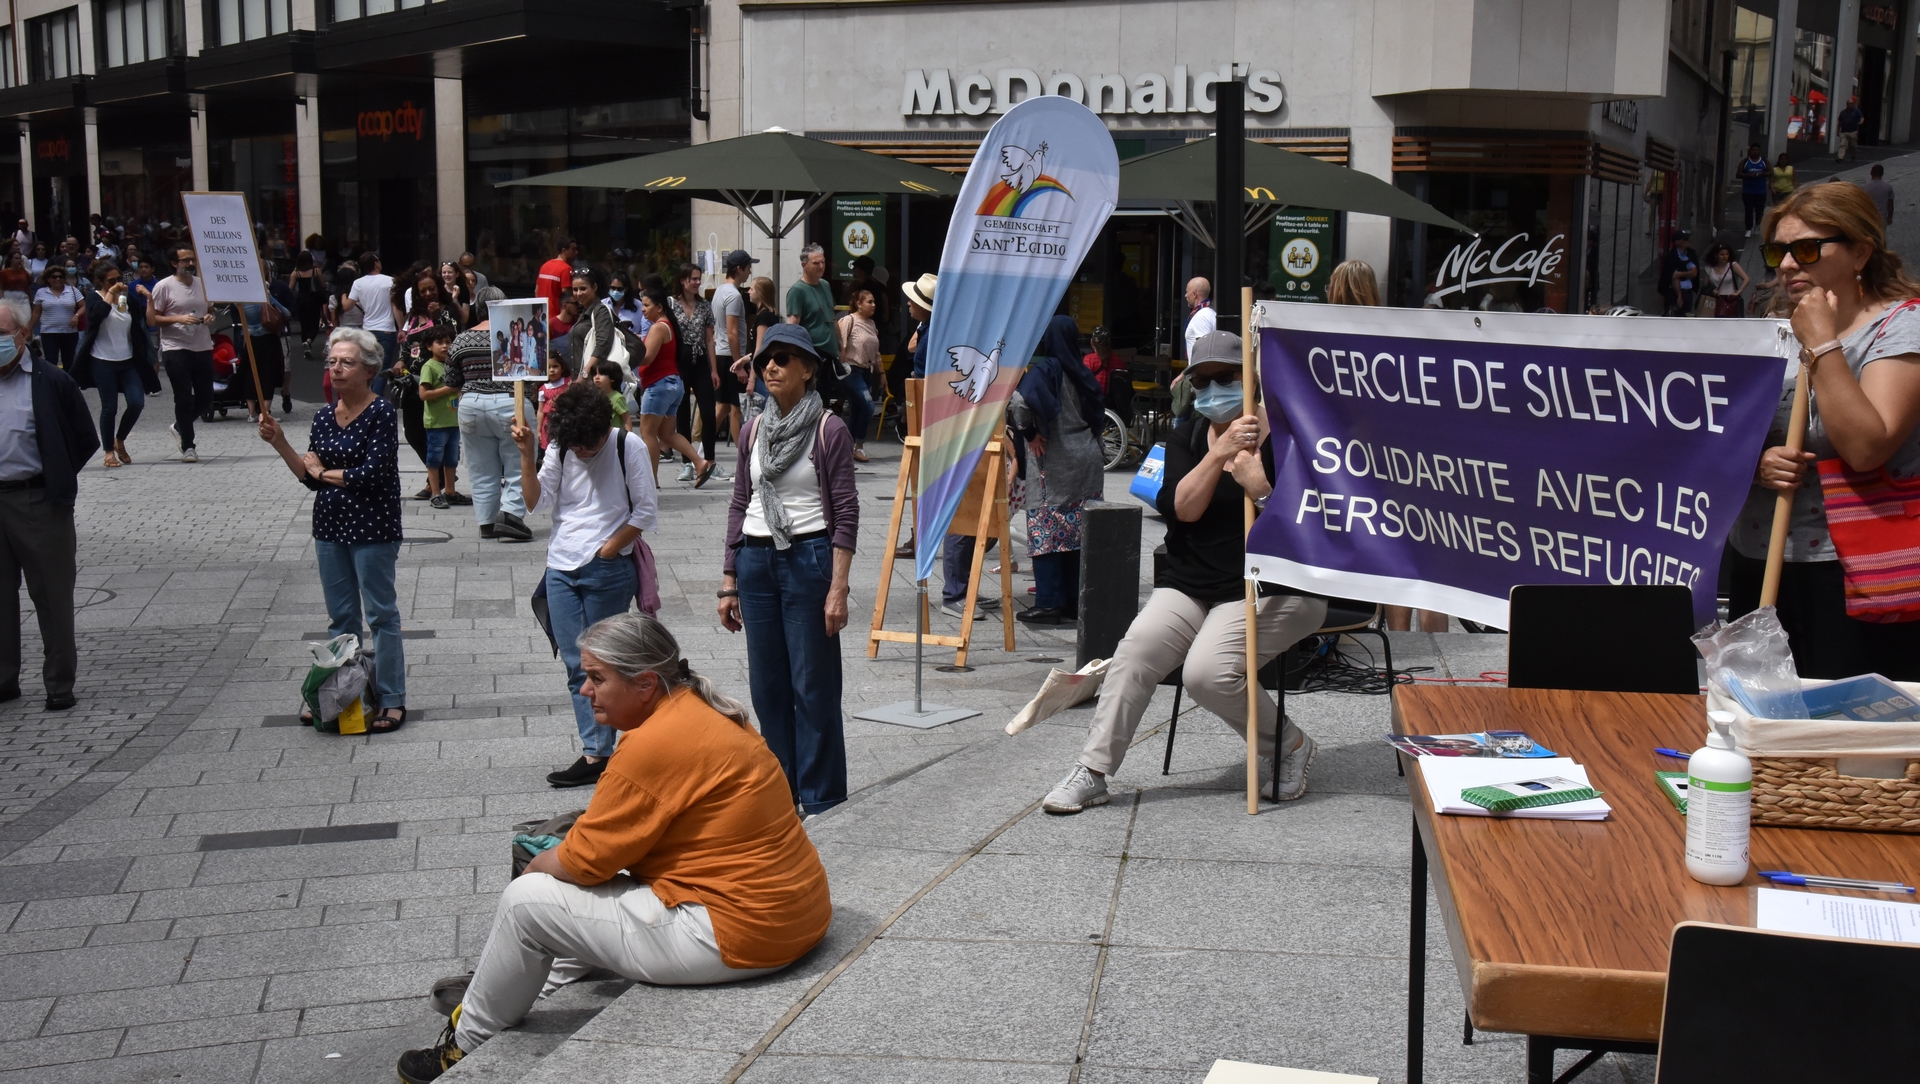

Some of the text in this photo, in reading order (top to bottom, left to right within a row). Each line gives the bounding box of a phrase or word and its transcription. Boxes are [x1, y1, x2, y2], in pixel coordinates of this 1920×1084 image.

[904, 63, 1283, 115] McDonald's
[358, 100, 424, 141] coop city
[38, 135, 69, 161] coop city
[210, 216, 226, 225] DES
[984, 219, 1060, 233] GEMEINSCHAFT
[203, 230, 242, 240] MILLIONS
[972, 233, 1066, 256] SANT'EGIDIO
[204, 245, 248, 254] D'ENFANTS
[213, 260, 245, 269] SUR LES
[1435, 232, 1565, 294] McCafé
[216, 274, 248, 283] ROUTES
[1308, 347, 1729, 434] CERCLE DE SILENCE
[1312, 437, 1710, 540] SOLIDARITE AVEC LES
[1296, 488, 1521, 562] PERSONNES
